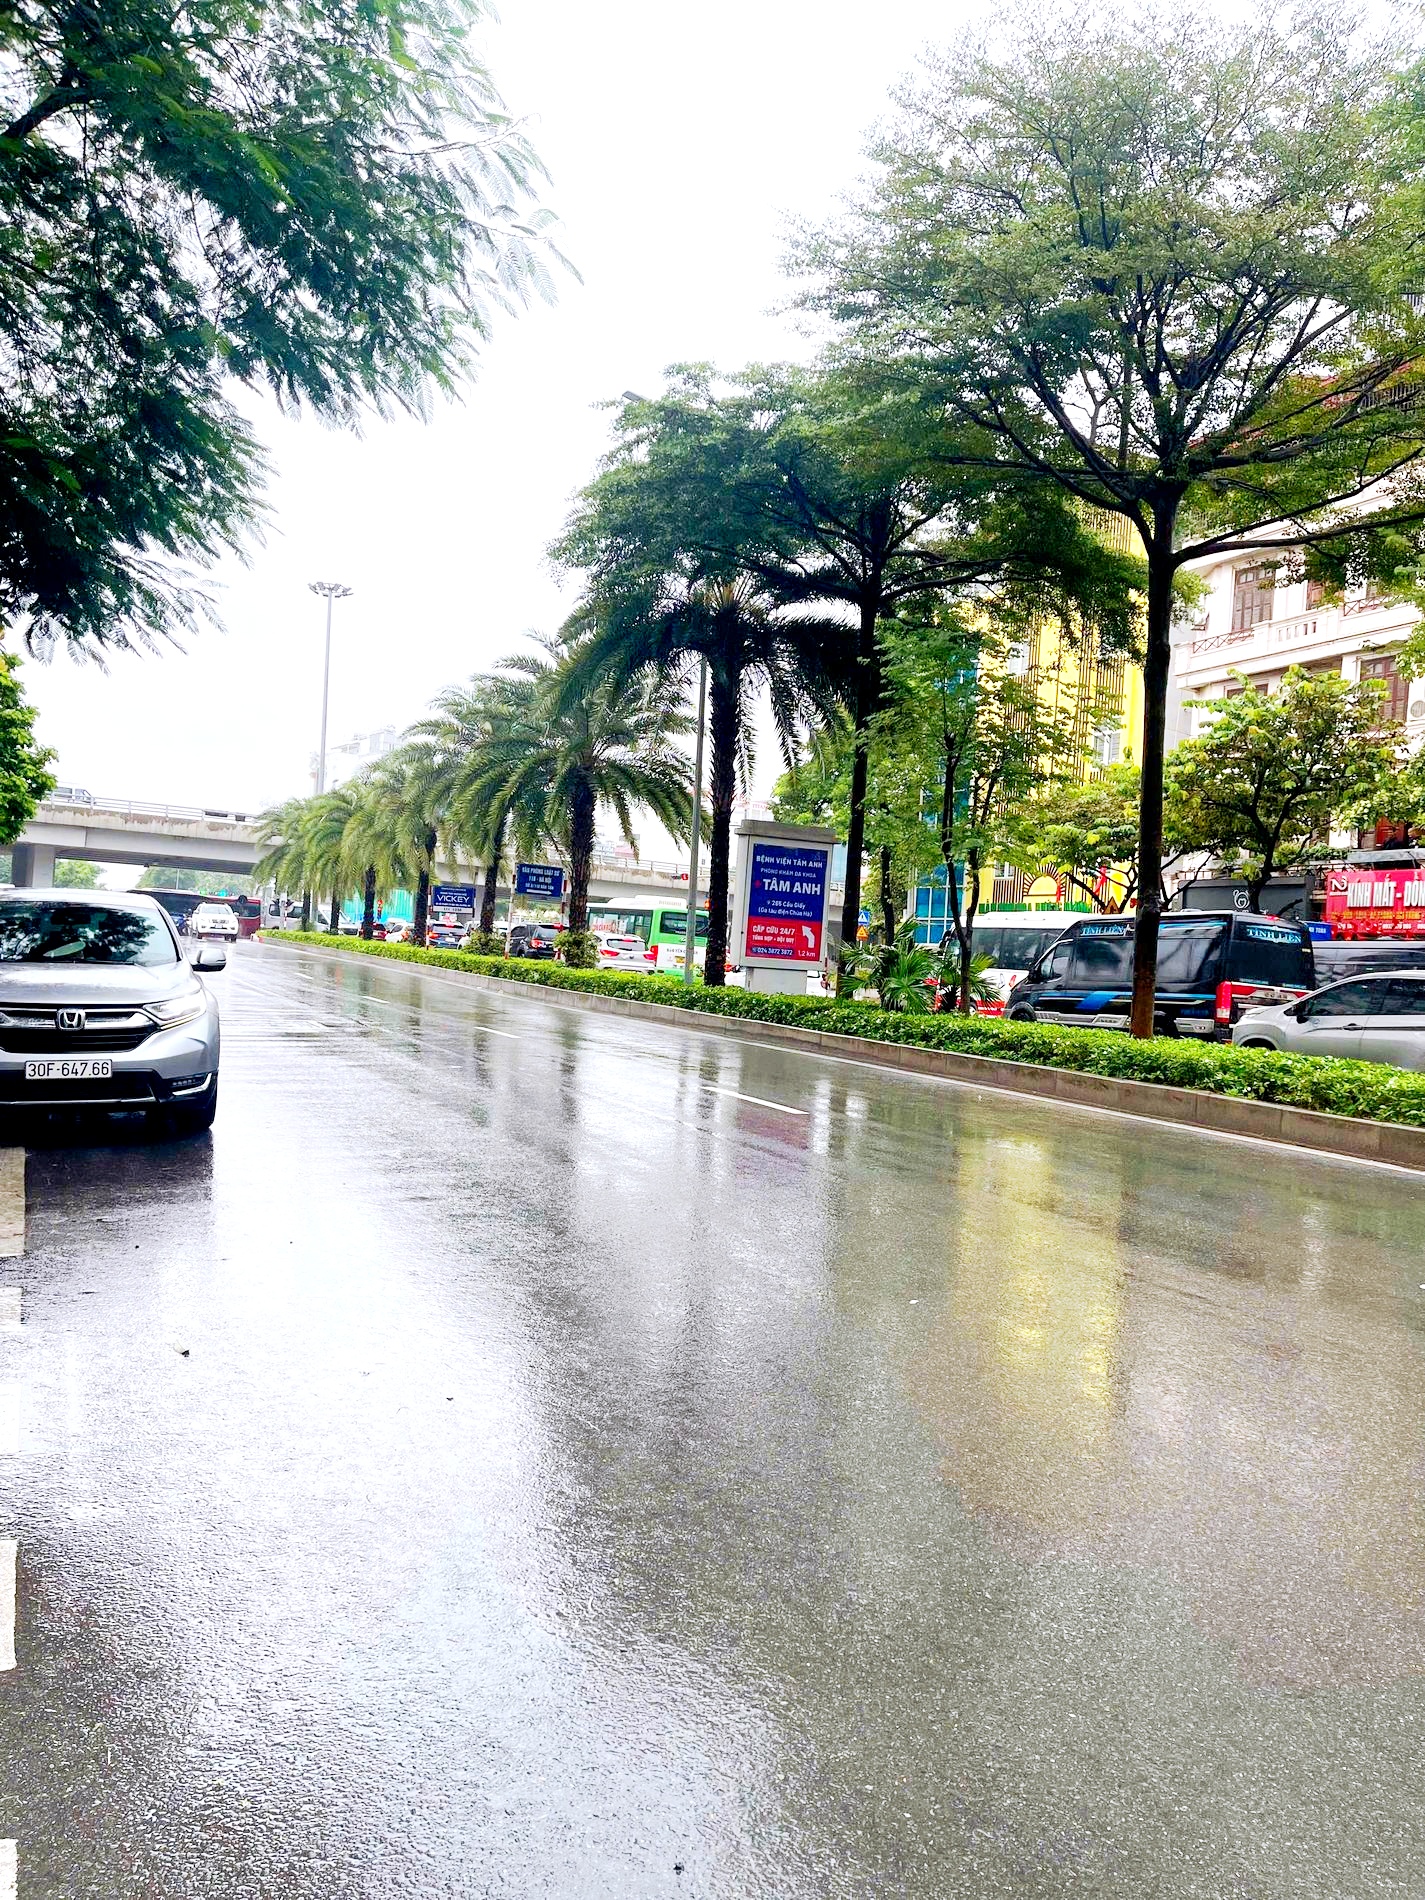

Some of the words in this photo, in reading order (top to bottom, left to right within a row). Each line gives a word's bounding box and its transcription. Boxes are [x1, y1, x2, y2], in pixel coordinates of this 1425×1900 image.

[763, 877, 790, 893] TÂM
[792, 881, 821, 896] ANH
[1347, 878, 1372, 907] KÍNH
[1373, 873, 1396, 907] MẮT
[436, 894, 470, 903] VICKEY
[752, 924, 765, 933] CẤP
[780, 927, 795, 935] 24/7
[28, 1061, 109, 1077] 30F-647.66
